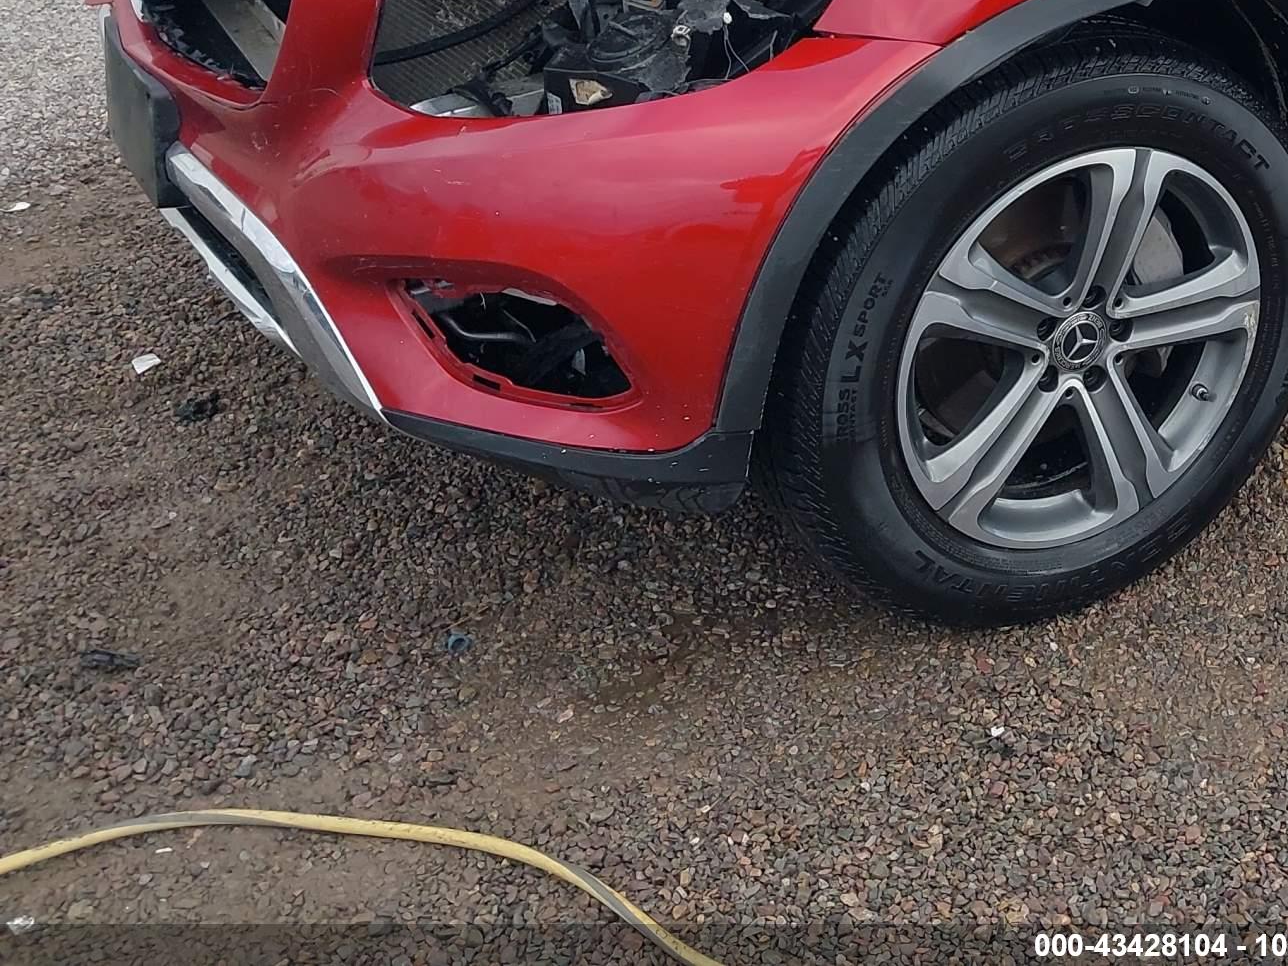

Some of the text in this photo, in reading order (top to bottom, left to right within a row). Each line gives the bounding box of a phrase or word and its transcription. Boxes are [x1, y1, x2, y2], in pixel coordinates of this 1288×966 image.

[841, 272, 887, 383] LX SPORT
[848, 390, 858, 440] ONTACT
